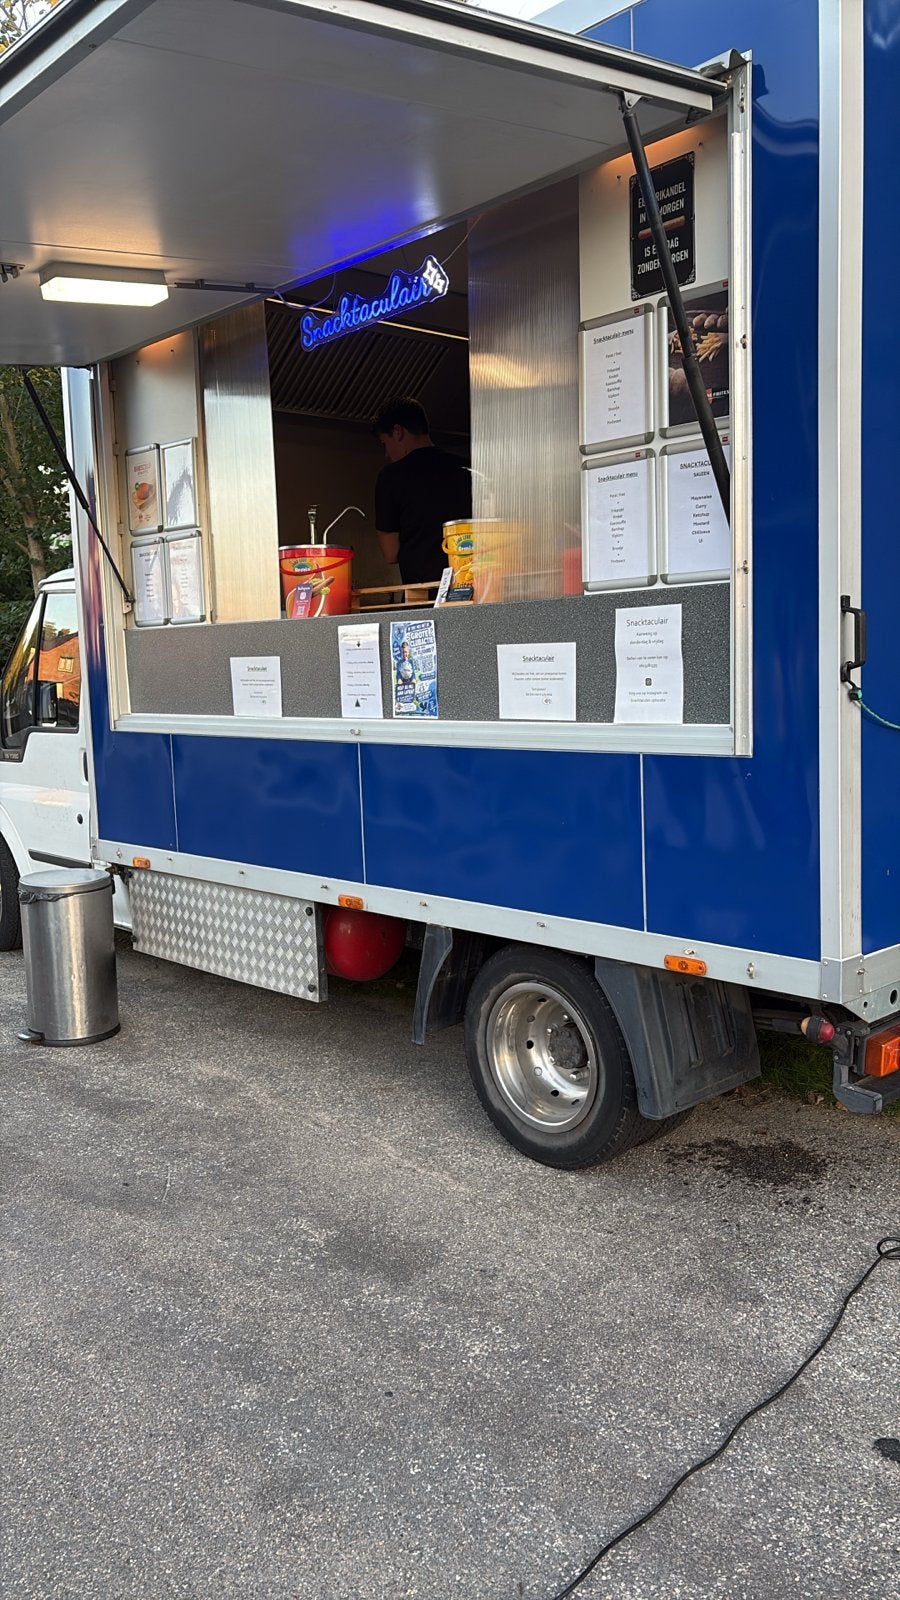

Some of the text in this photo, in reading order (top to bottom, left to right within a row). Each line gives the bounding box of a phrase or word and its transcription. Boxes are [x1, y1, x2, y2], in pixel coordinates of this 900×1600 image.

[655, 182, 686, 201] RIKANDEL
[640, 212, 646, 223] IN
[644, 246, 651, 257] IS
[671, 249, 689, 264] RGEN
[626, 617, 669, 627] Snacktaculair
